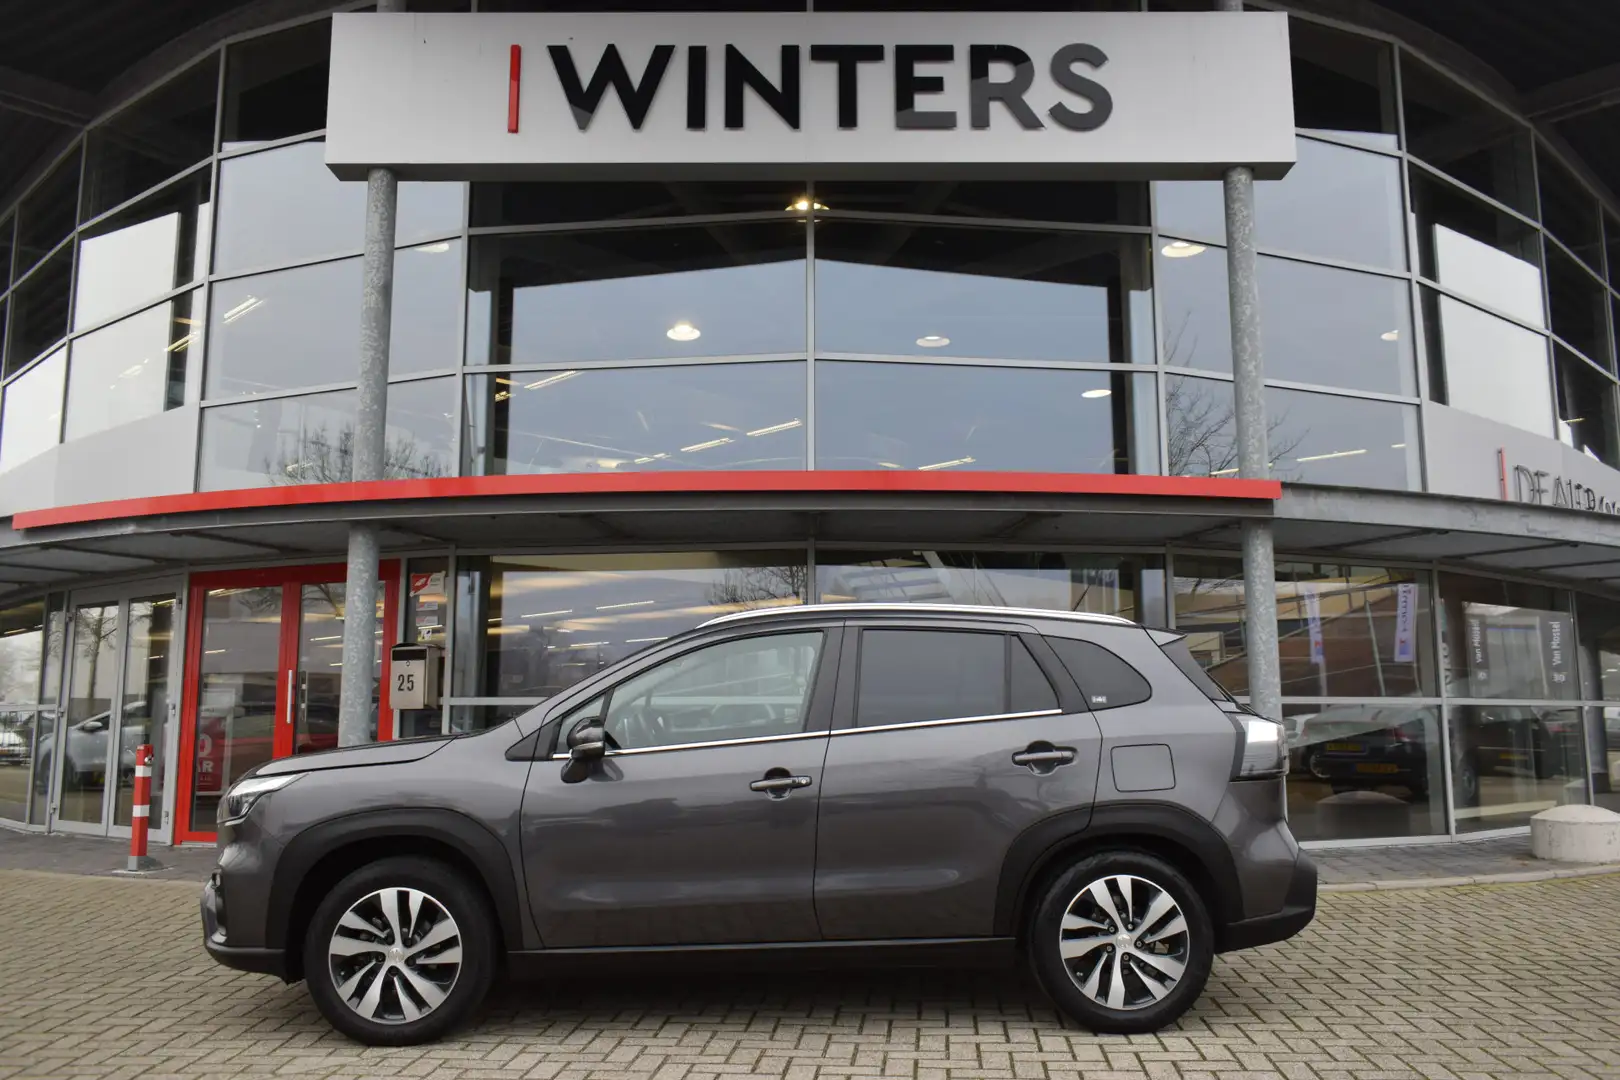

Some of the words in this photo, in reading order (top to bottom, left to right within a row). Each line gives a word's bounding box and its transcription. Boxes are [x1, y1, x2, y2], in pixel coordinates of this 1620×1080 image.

[546, 42, 1113, 132] WINTERS
[1548, 621, 1562, 649] Mossel
[397, 674, 415, 692] 25
